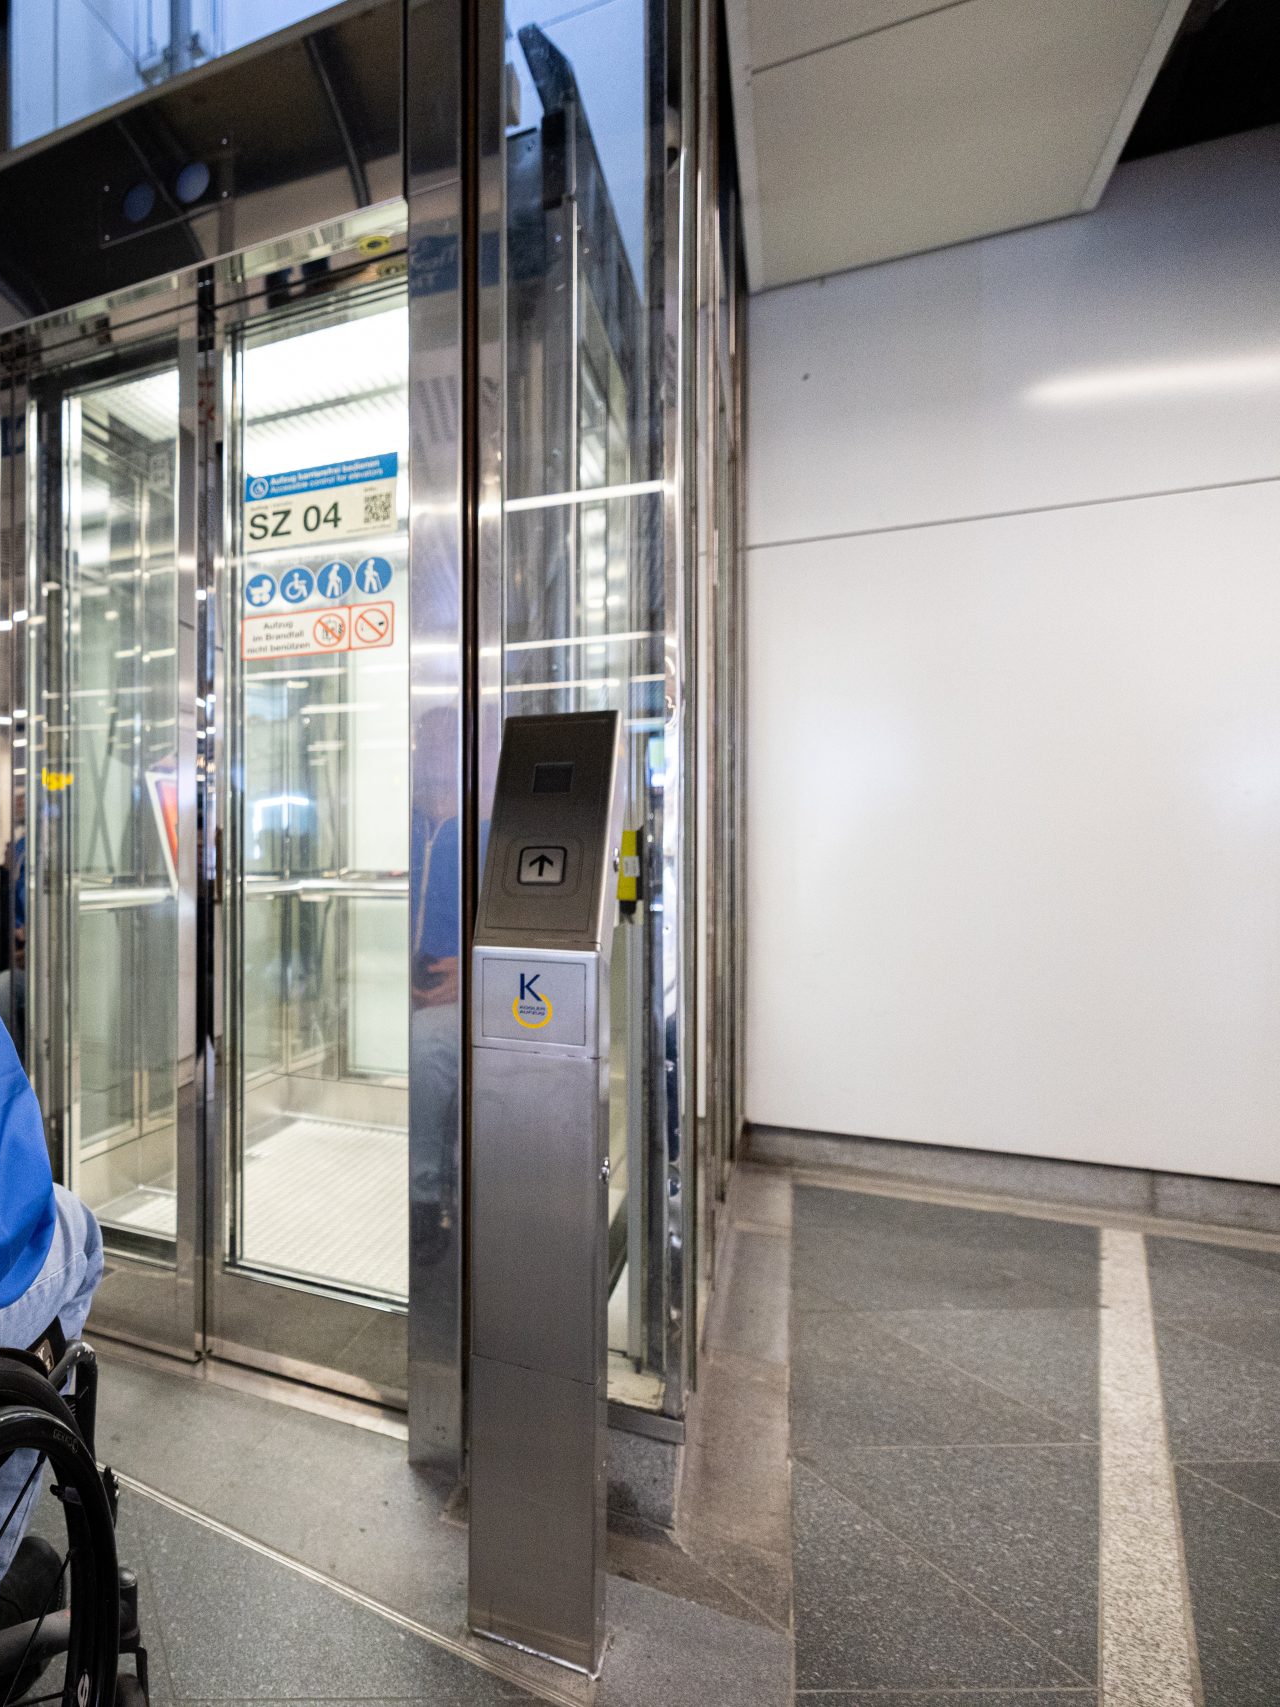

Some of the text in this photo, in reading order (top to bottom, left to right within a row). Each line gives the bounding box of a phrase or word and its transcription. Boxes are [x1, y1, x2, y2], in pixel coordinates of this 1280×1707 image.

[270, 475, 297, 486] Aufzug
[249, 501, 342, 540] SZ 04
[263, 620, 294, 631] Aufzug
[252, 629, 305, 642] im Brandfall
[246, 644, 268, 654] nicht
[520, 973, 542, 1001] K
